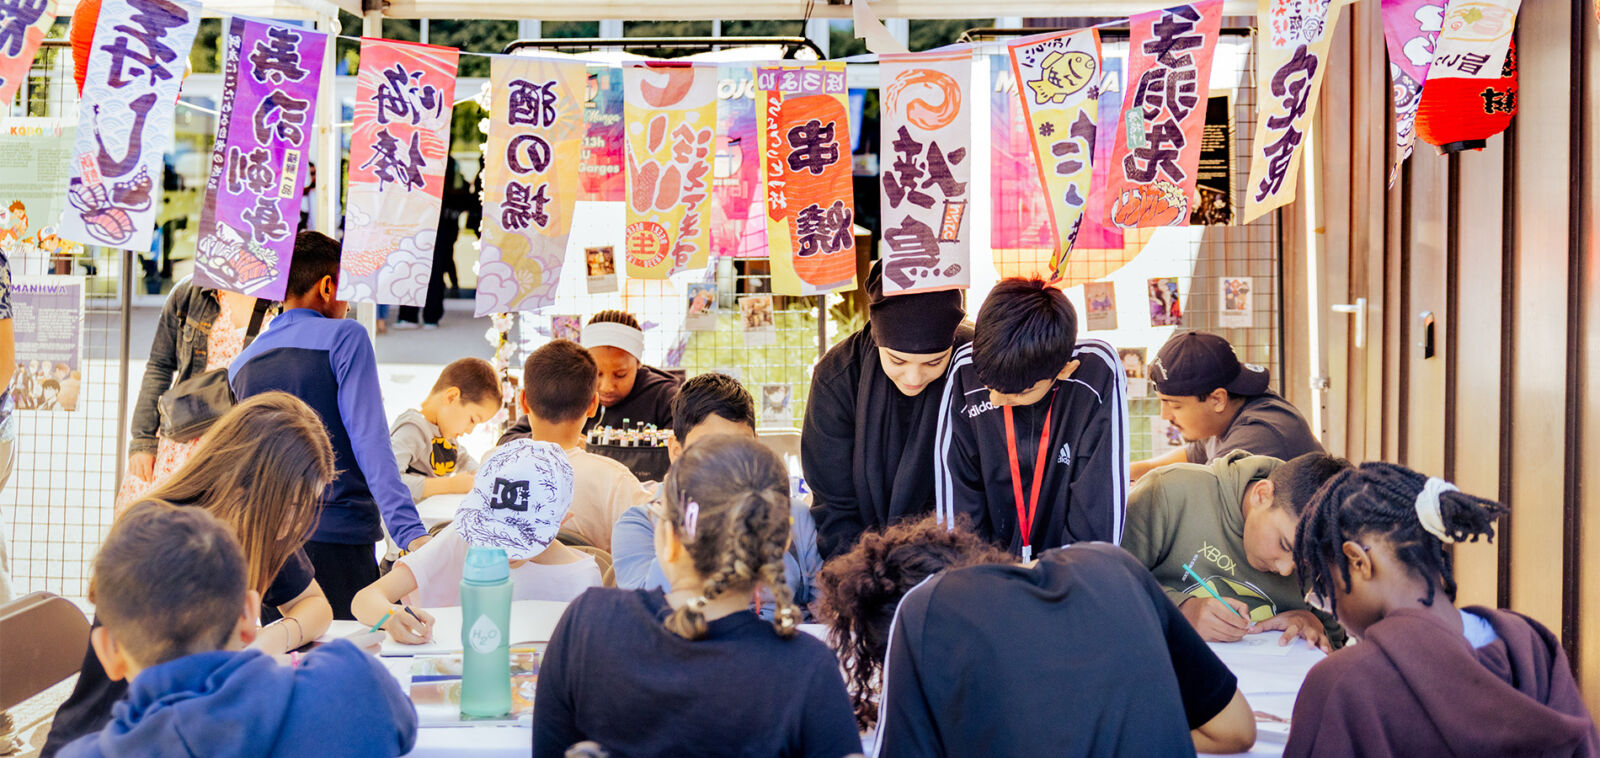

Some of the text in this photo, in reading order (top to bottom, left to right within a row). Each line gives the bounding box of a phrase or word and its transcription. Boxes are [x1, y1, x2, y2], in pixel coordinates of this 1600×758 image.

[578, 162, 620, 176] Garges
[11, 284, 66, 295] MANHWA
[490, 476, 530, 512] DC
[1197, 540, 1237, 576] XBOX
